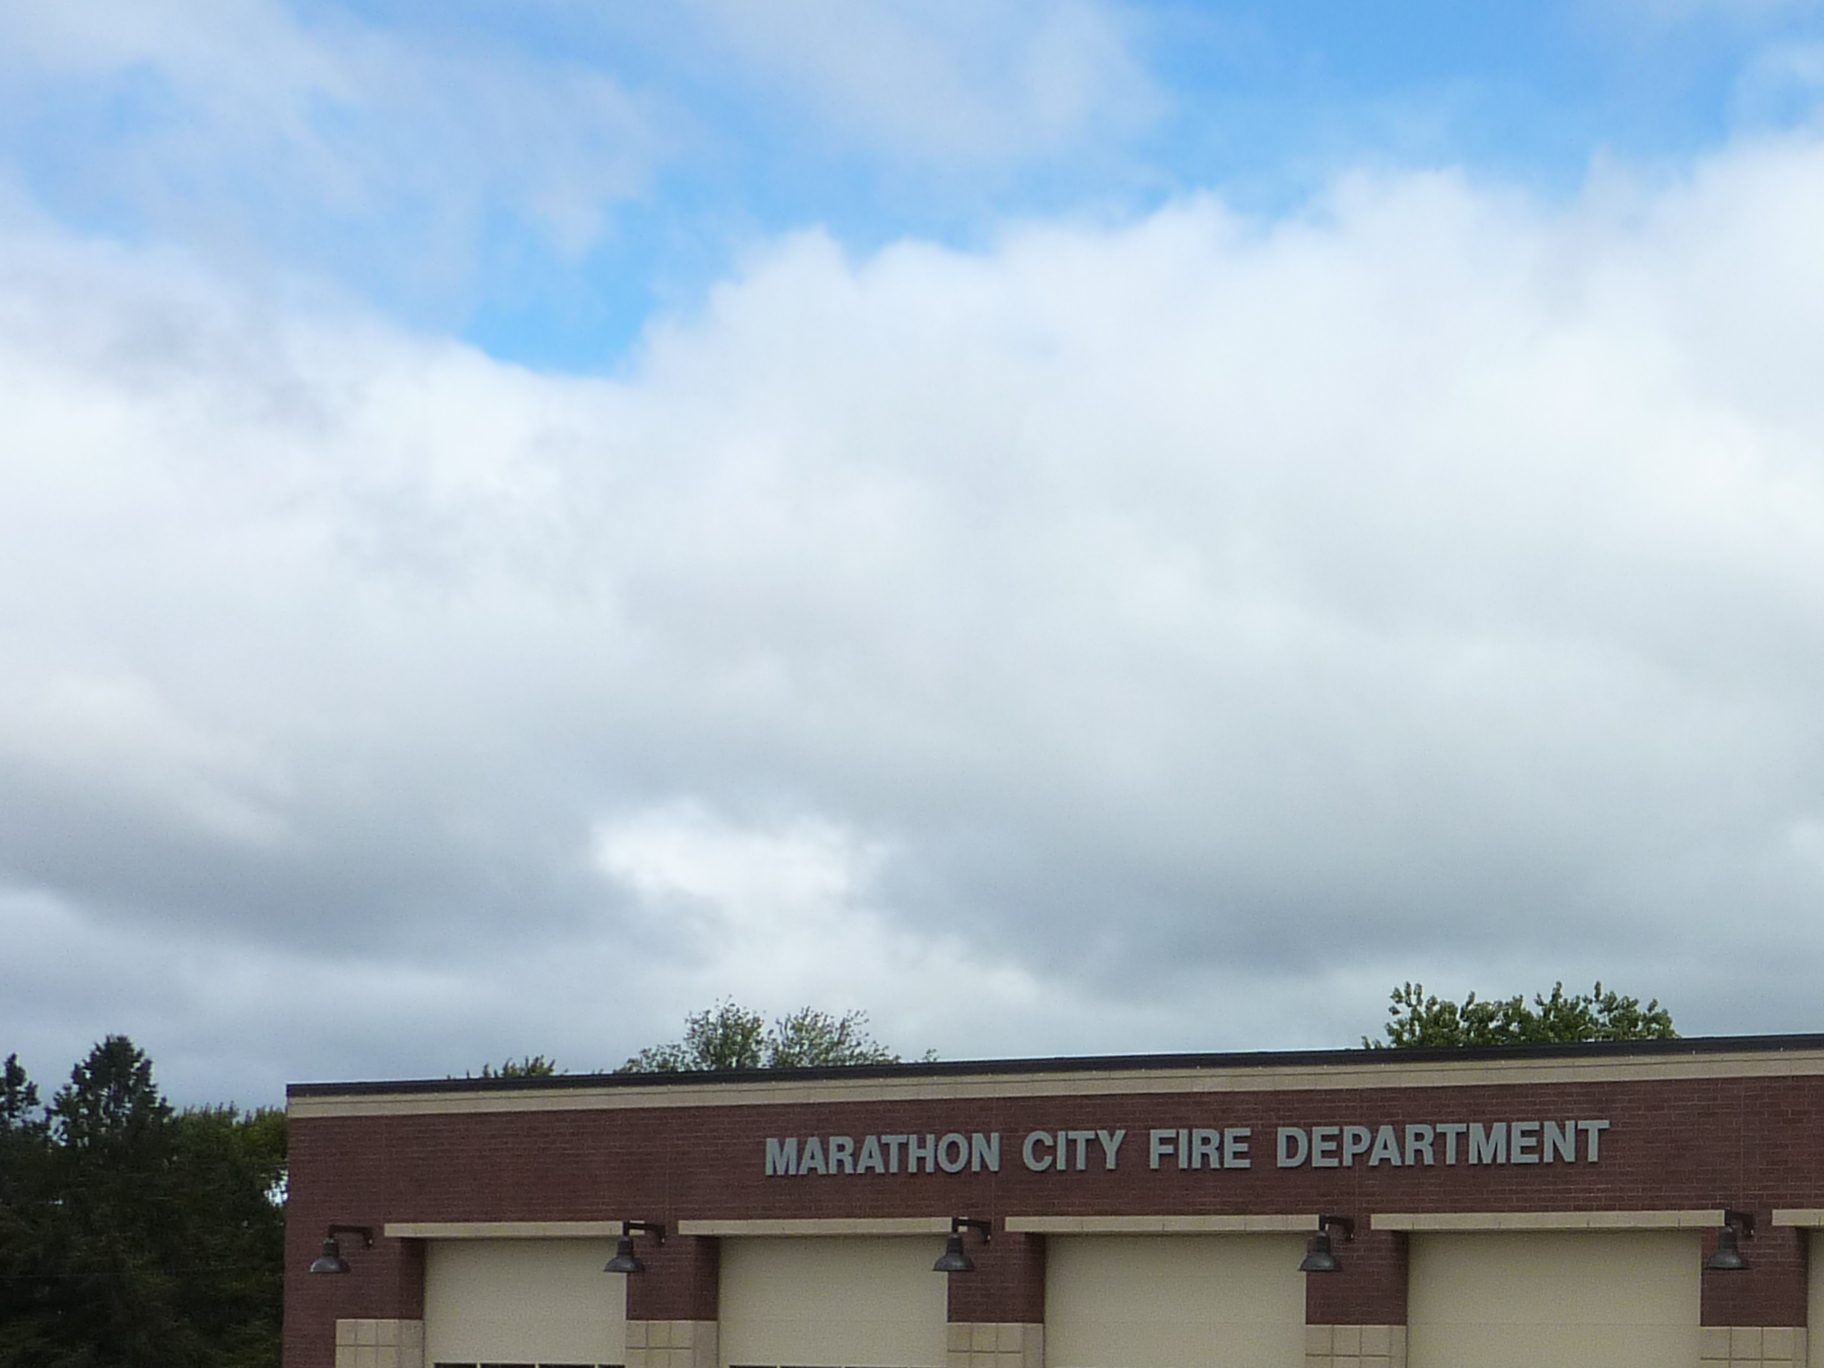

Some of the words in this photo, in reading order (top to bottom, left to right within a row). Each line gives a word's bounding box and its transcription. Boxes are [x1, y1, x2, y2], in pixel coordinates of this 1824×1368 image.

[765, 1132, 1000, 1176] MARATHON
[1022, 1129, 1125, 1172] CITY
[1149, 1127, 1252, 1170] FIRE
[1276, 1120, 1611, 1168] DEPARTMENT
